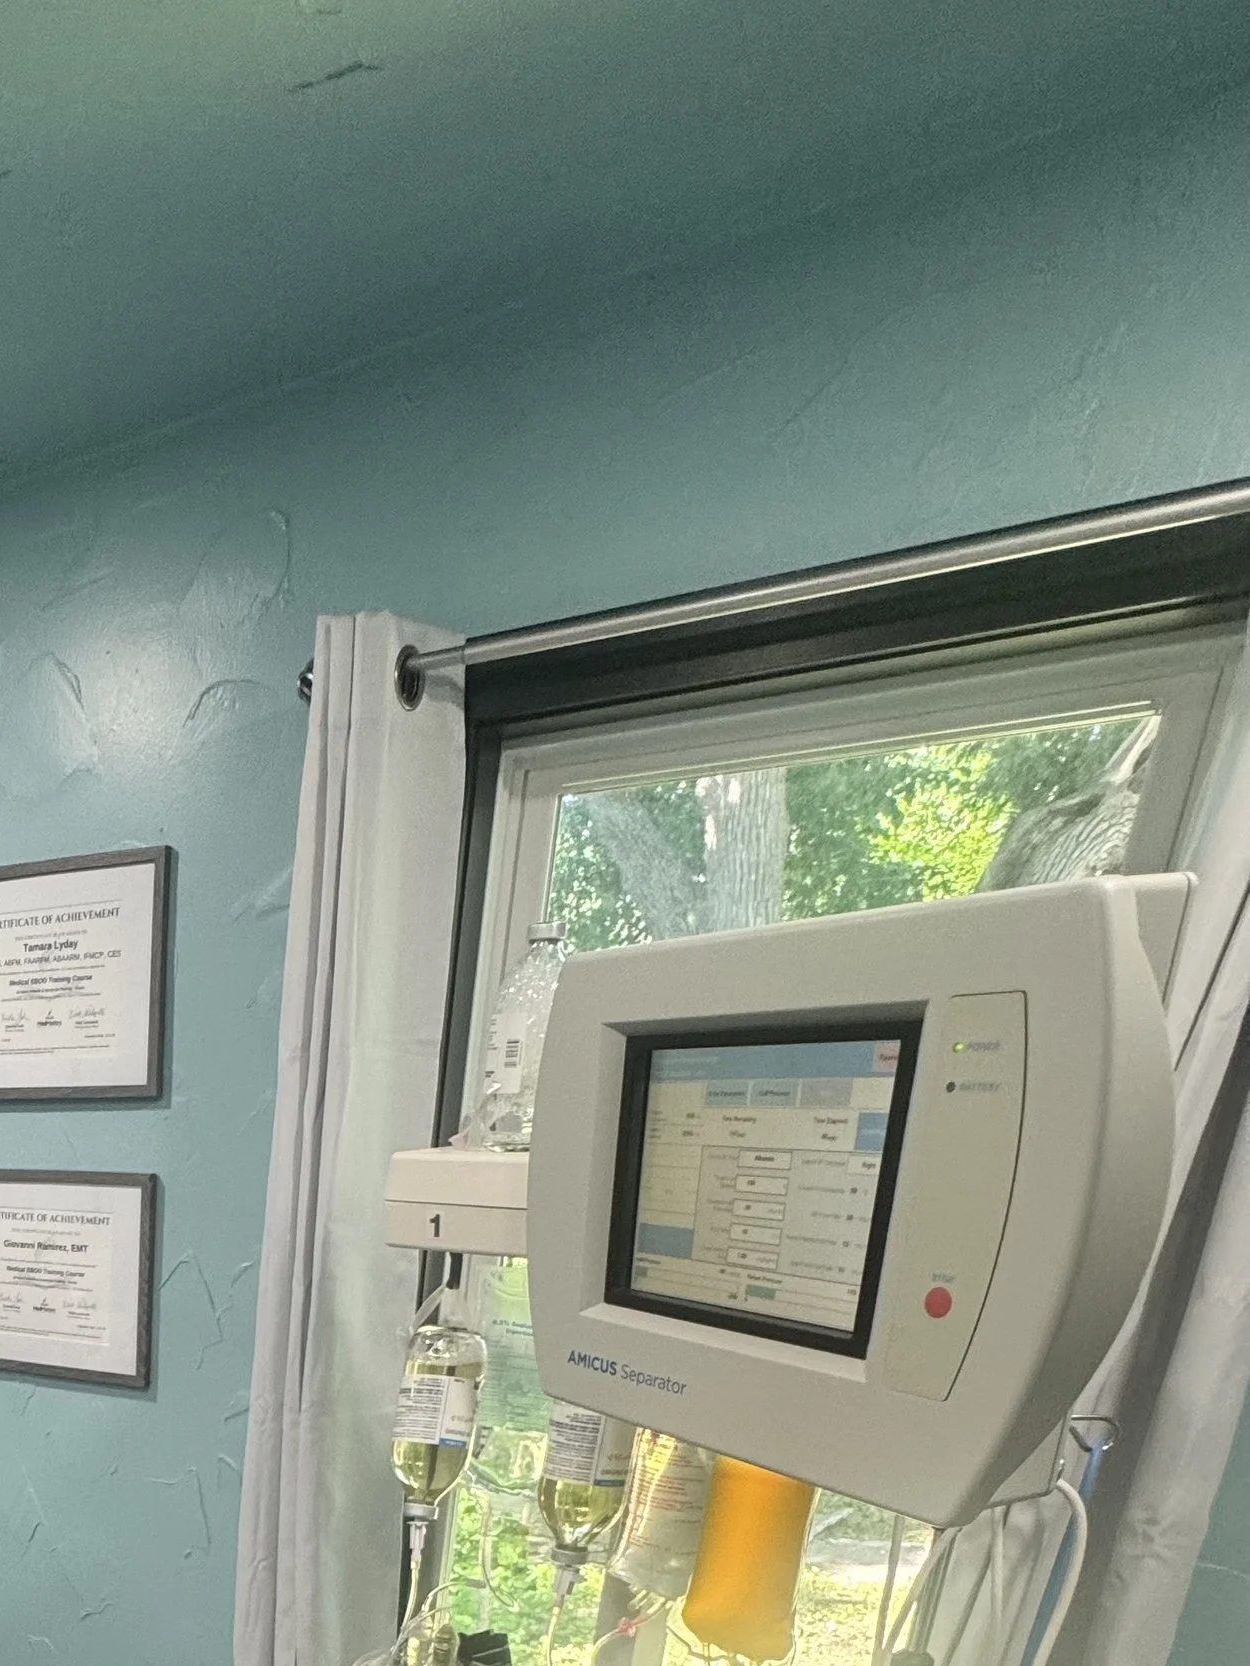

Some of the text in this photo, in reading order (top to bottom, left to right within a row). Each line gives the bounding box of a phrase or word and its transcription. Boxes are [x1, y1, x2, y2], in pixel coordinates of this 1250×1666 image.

[41, 915, 53, 925] OF
[55, 907, 120, 923] ACHIEVEMENT
[23, 940, 78, 952] Tamara Lyday
[36, 1213, 48, 1223] OF
[49, 1214, 111, 1226] ACHIEVEMENT
[429, 1213, 442, 1238] 1
[3, 1239, 89, 1254] Giovanni Ramirez, EMT
[567, 1350, 687, 1395] AMICUS Separator
